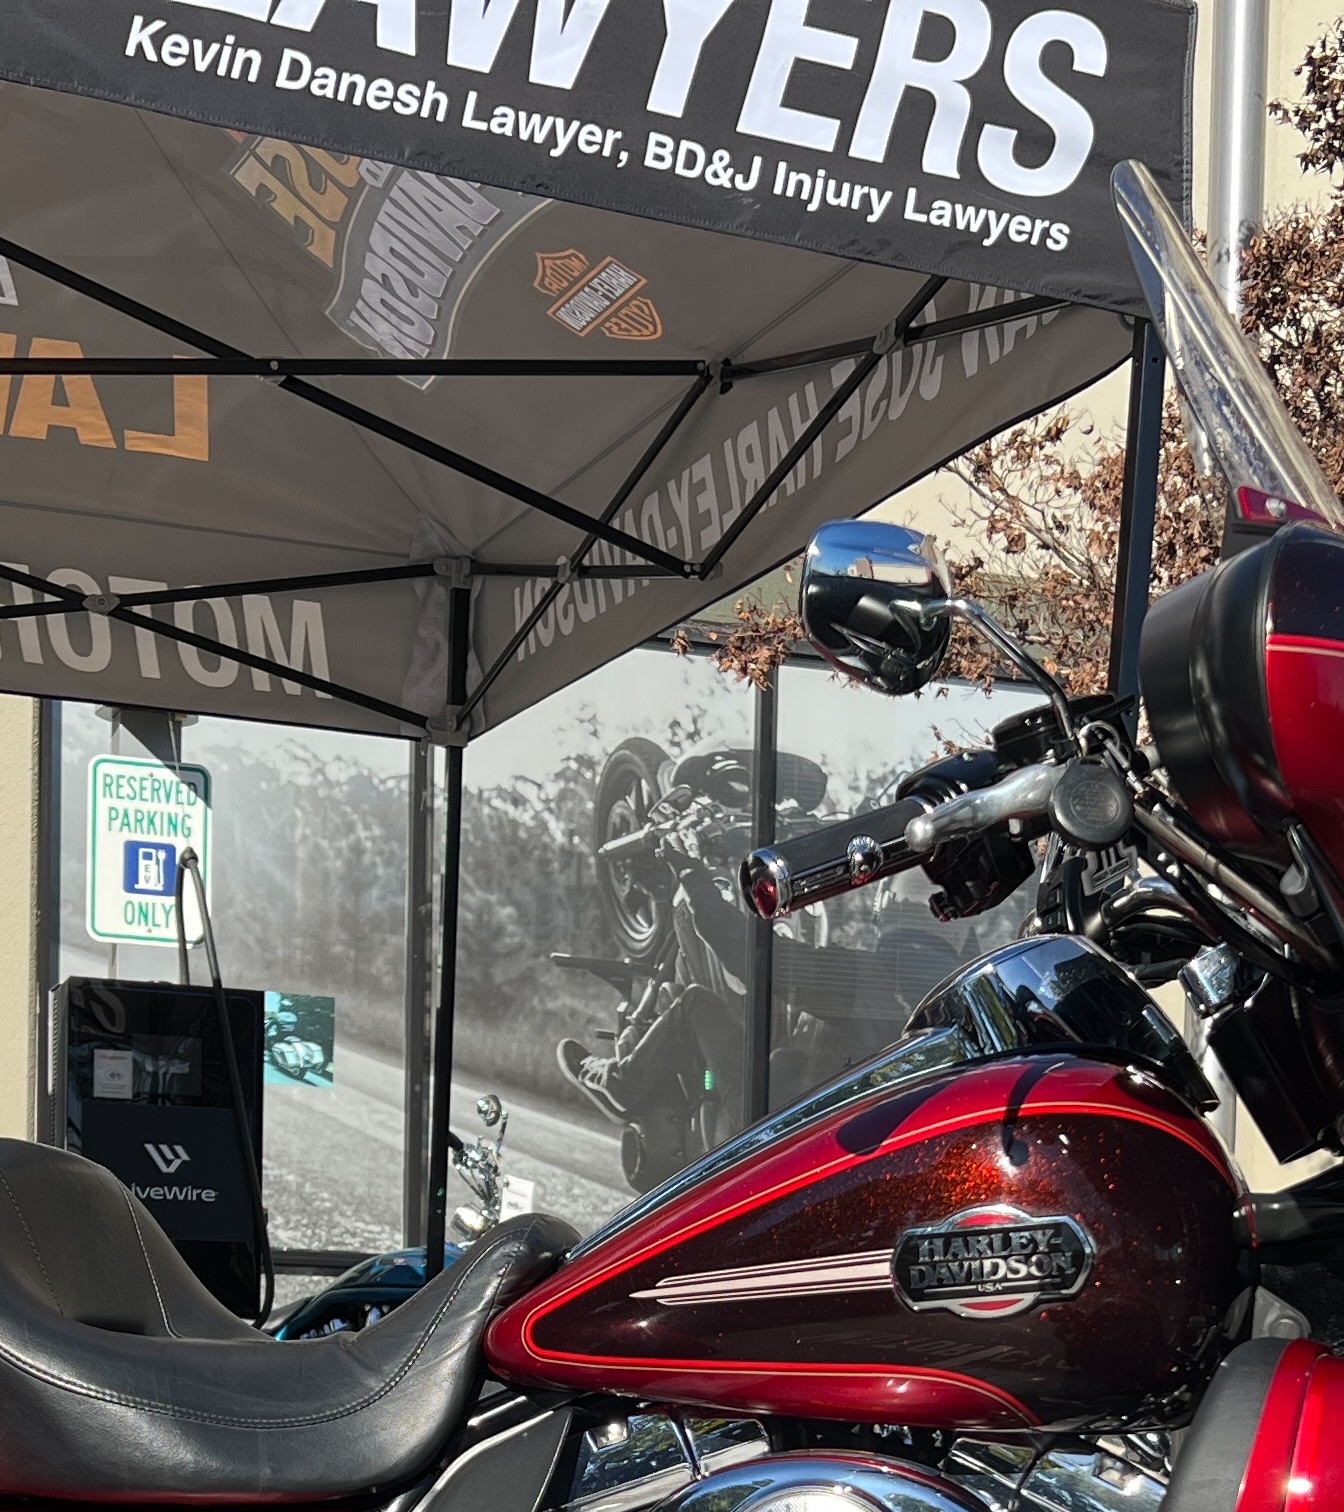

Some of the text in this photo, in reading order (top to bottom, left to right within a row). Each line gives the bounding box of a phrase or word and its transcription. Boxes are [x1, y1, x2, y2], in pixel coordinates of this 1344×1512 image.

[171, 0, 1109, 198] YERS
[124, 14, 1072, 254] Kevin Danesh Lawyer, BD&J Injury Lawyers
[102, 772, 199, 808] RESERVED
[107, 806, 194, 840] PARKING
[123, 900, 176, 929] ONLY
[131, 1182, 217, 1203] iveWire
[916, 1228, 1064, 1263] HARLEY-
[909, 1251, 1077, 1290] DAVIDSON
[977, 1282, 1003, 1293] USA
